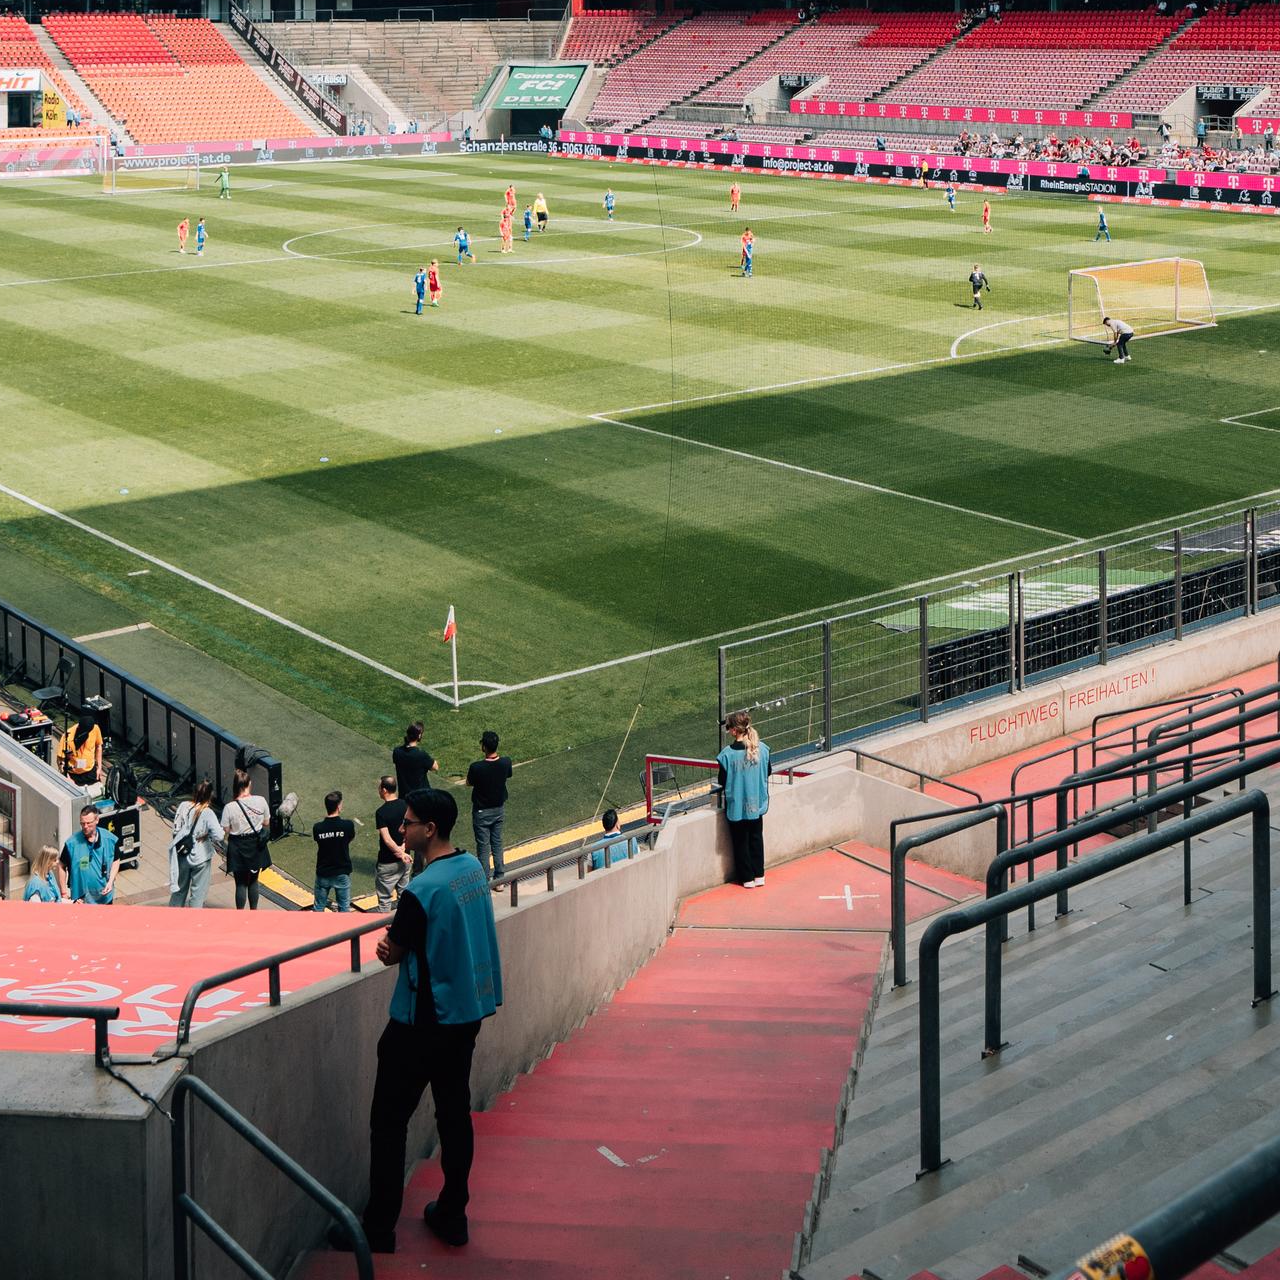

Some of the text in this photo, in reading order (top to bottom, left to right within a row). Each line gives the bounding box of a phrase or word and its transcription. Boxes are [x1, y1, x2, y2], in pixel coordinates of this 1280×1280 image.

[519, 80, 566, 90] FC!
[460, 140, 601, 155] Schanzenstraße 36 51063 Köln
[763, 157, 834, 173] info@project-at.de
[1047, 164, 1057, 176] T
[1040, 179, 1116, 193] RheinEnergieSTADION
[970, 667, 1156, 744] FLUCHTWEG FREIHALTEN !
[319, 831, 334, 839] TEAM
